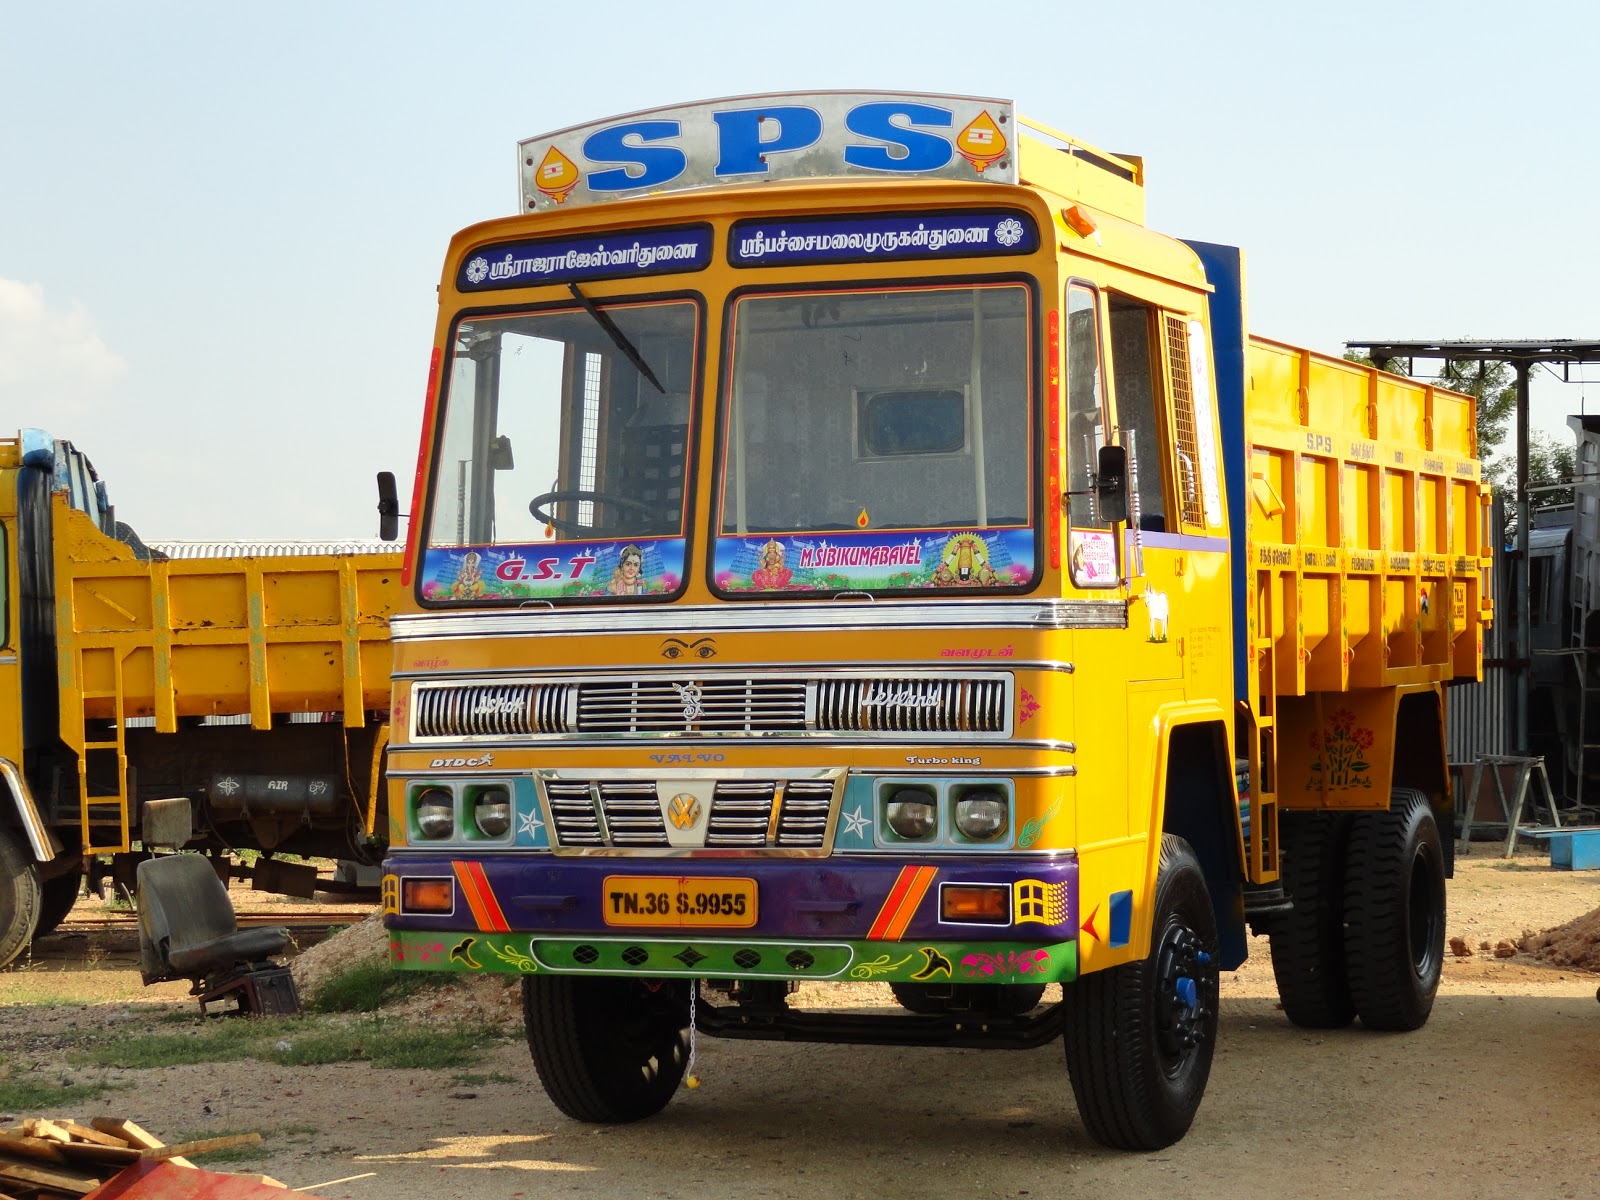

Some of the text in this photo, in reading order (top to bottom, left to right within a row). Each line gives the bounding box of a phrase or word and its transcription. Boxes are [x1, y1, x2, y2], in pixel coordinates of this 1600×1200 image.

[581, 101, 955, 193] SPS
[1306, 432, 1332, 453] S.P.S
[496, 557, 596, 581] G.S.T
[941, 645, 1015, 659] வளமுடன்
[475, 688, 939, 714] Ashok Leyland
[430, 758, 478, 768] DTDC
[650, 753, 725, 764] VALVO
[905, 755, 982, 766] Turbo king
[267, 780, 289, 791] AIR
[610, 892, 746, 915] TN.36 S.9955
